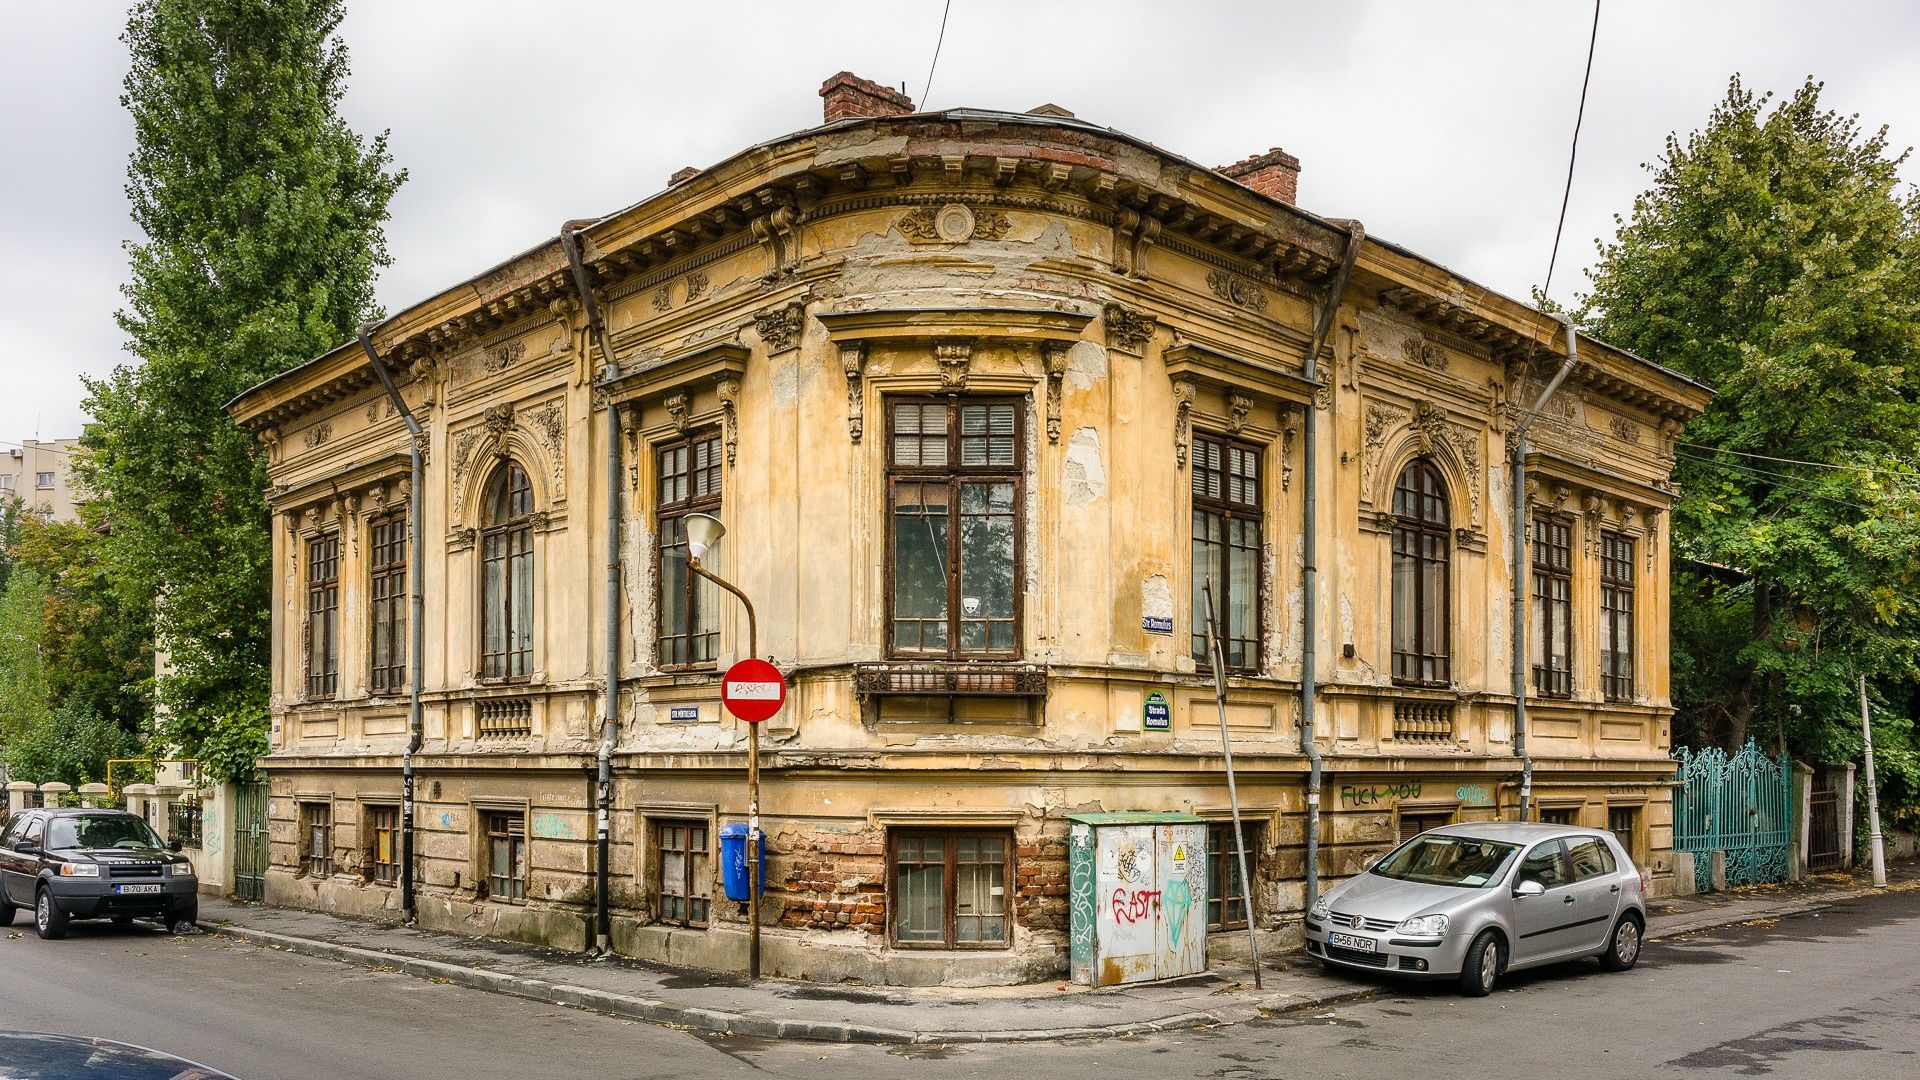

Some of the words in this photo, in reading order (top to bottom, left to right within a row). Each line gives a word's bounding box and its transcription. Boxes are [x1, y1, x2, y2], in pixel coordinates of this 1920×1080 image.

[1151, 619, 1171, 630] Romulus
[1148, 706, 1166, 714] Strada
[1146, 717, 1168, 726] Romulus
[1341, 786, 1378, 808] FUCK
[1112, 887, 1161, 925] EAST!
[1354, 938, 1373, 950] NDR
